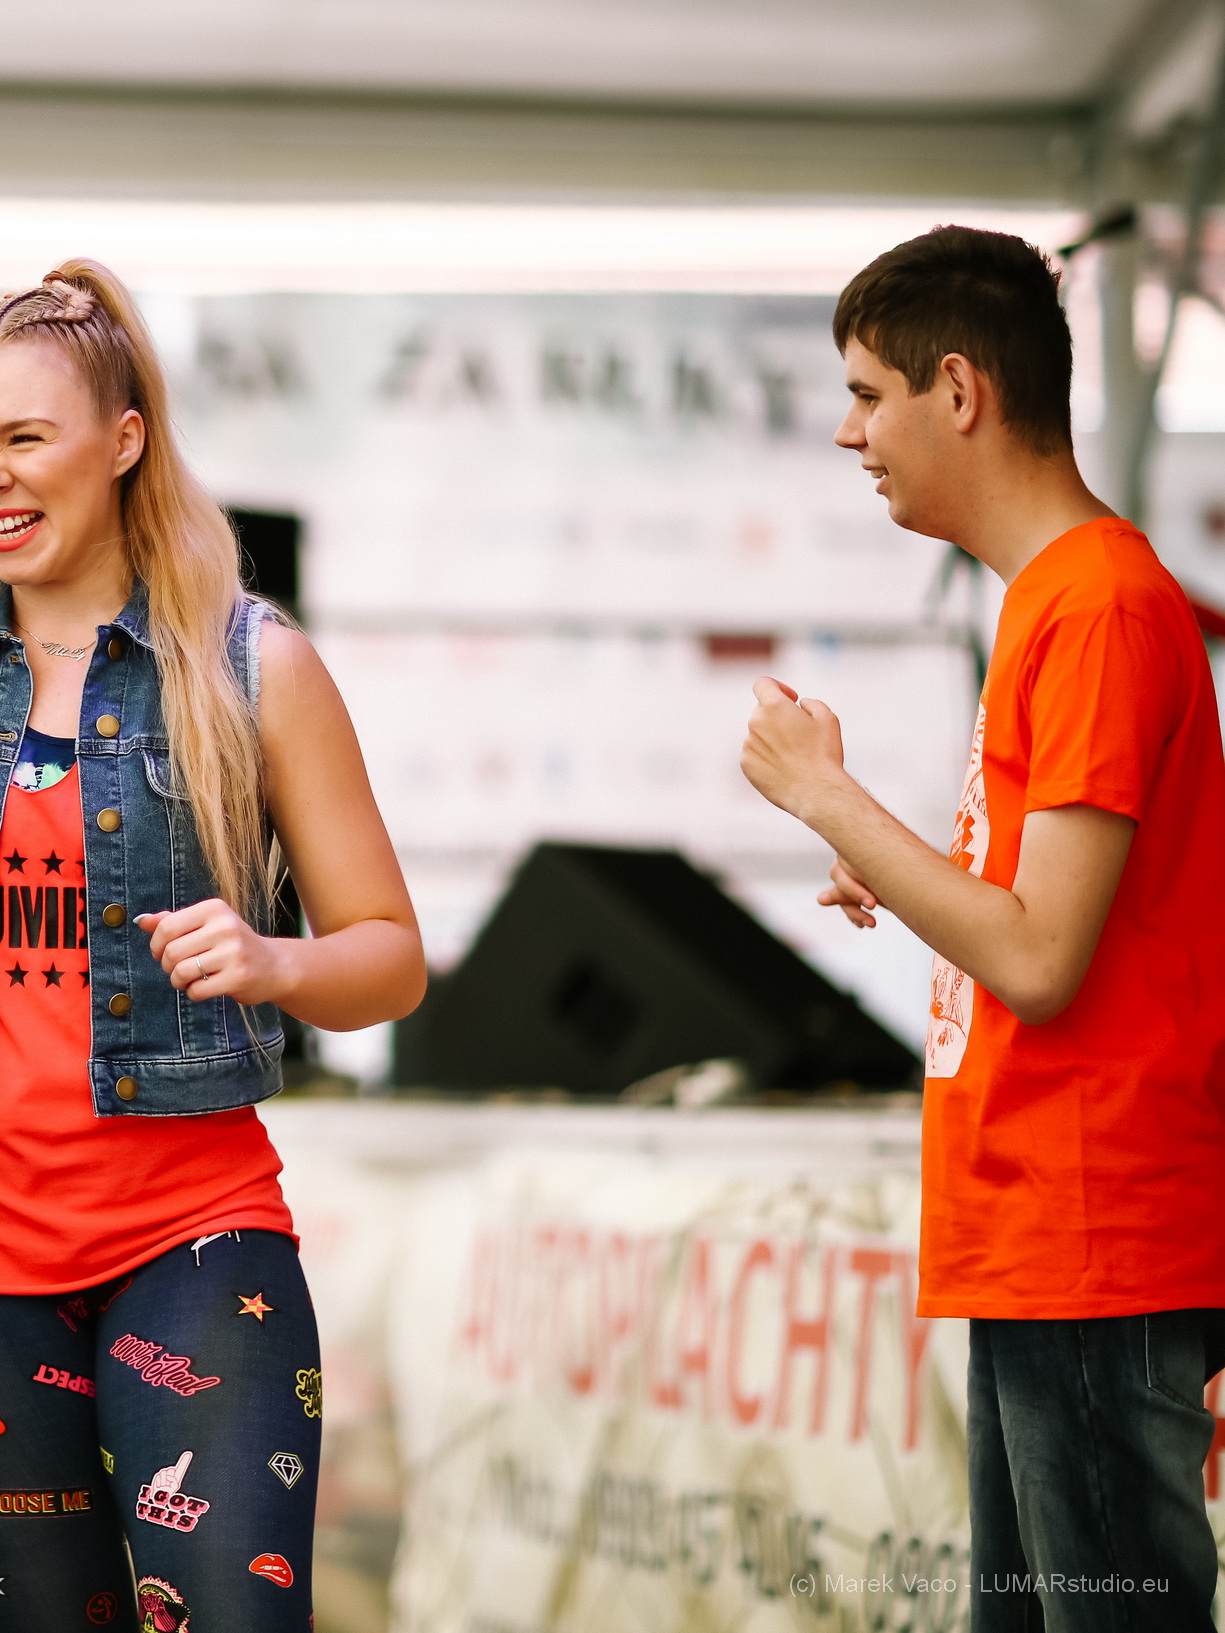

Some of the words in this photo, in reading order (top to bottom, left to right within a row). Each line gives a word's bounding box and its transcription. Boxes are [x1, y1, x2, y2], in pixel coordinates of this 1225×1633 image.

[141, 1353, 221, 1396] Real
[61, 1490, 91, 1512] ME
[139, 1486, 151, 1501] I
[153, 1490, 208, 1517] GOT
[137, 1502, 197, 1532] THIS
